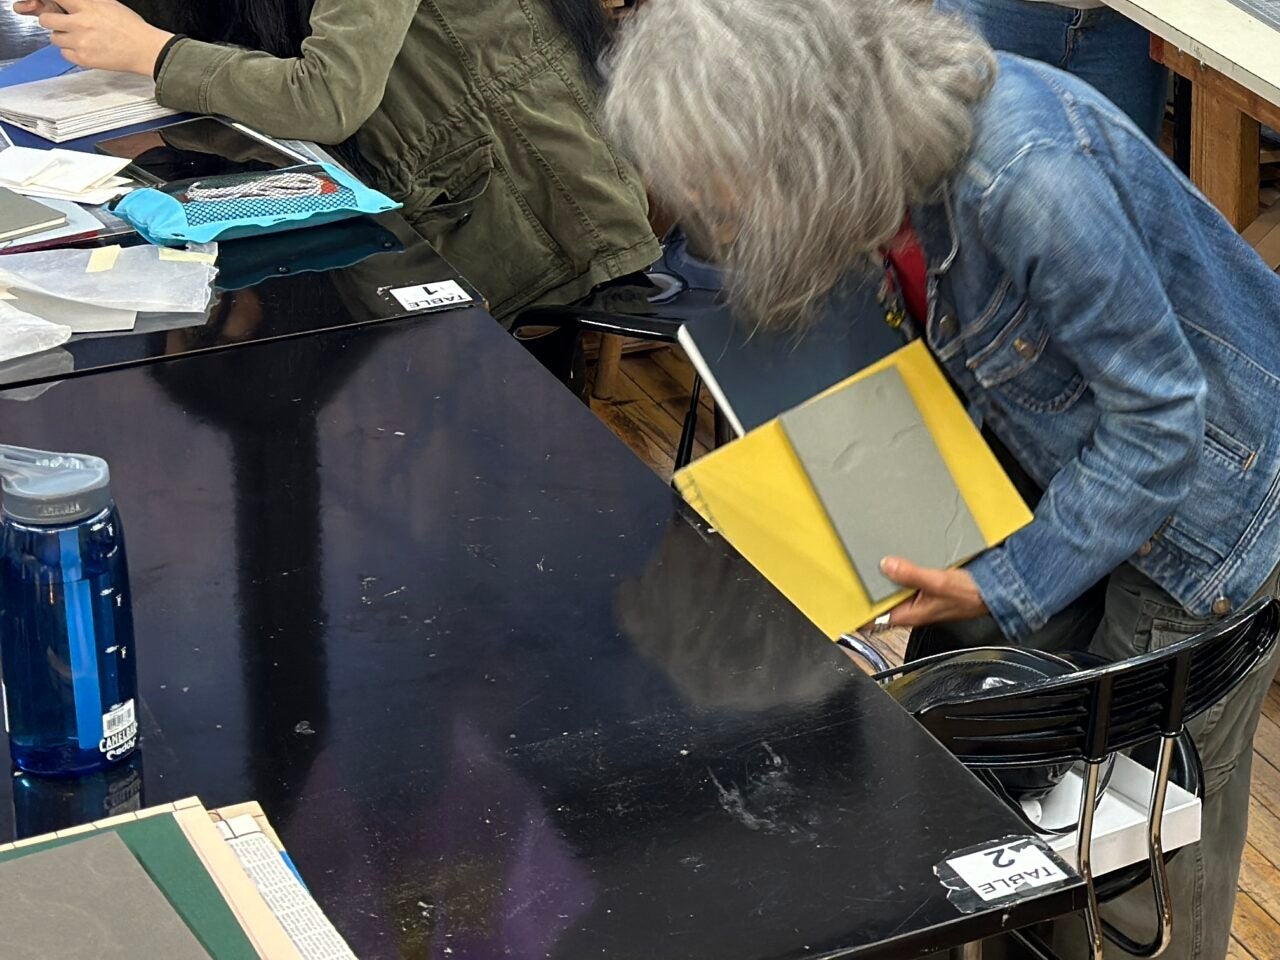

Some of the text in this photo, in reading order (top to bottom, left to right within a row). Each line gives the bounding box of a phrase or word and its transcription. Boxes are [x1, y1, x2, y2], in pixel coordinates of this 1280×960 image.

[422, 286, 439, 296] 1
[408, 293, 468, 309] TABLE
[983, 848, 1016, 868] 2
[977, 866, 1057, 895] TABLE
